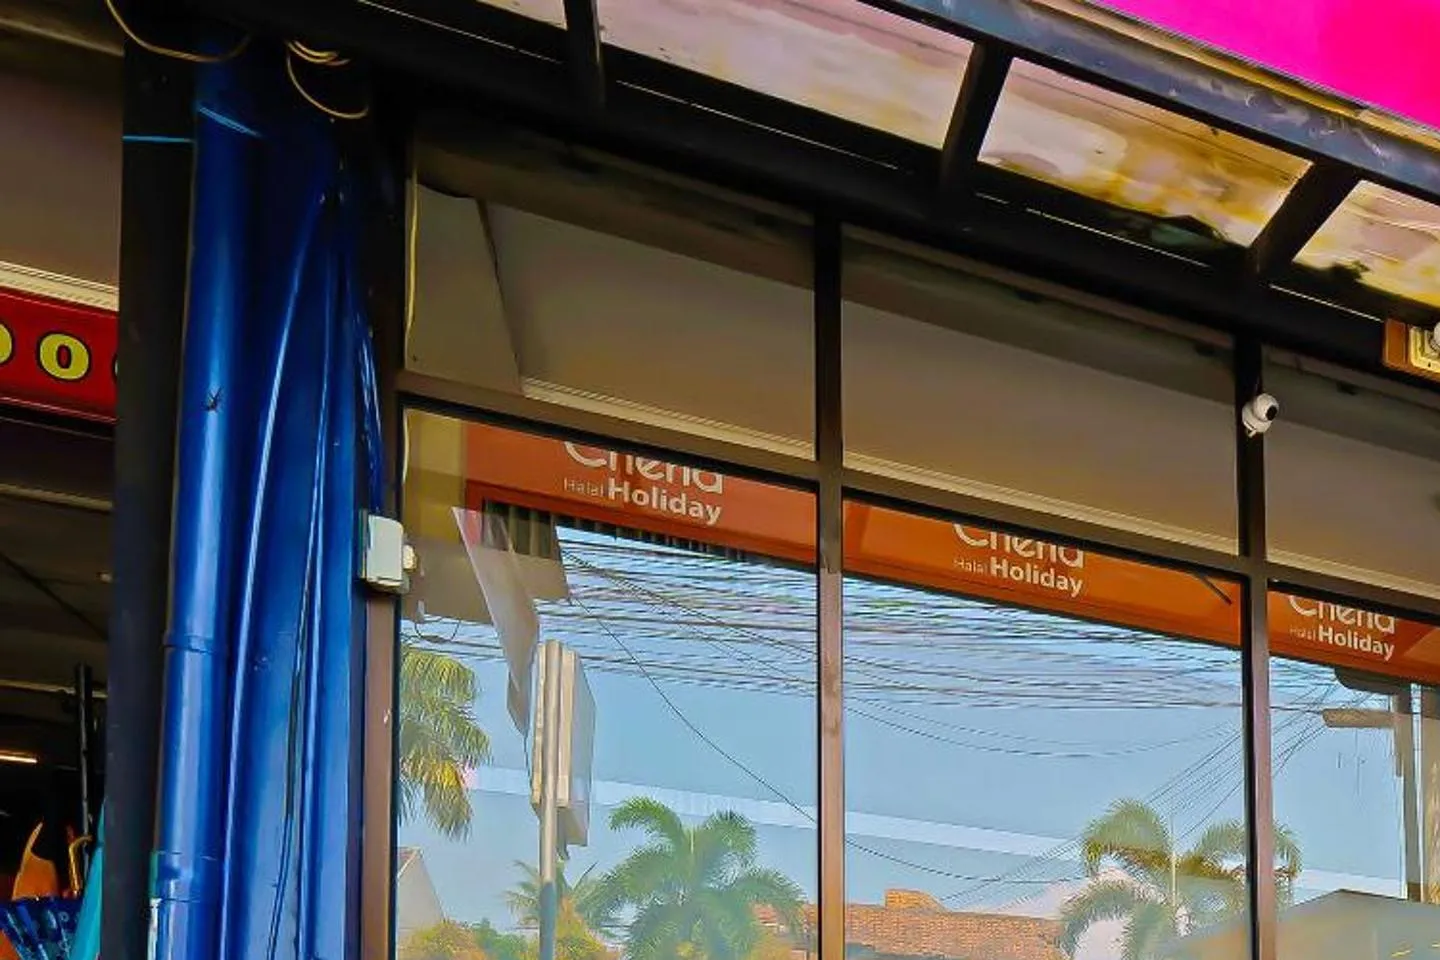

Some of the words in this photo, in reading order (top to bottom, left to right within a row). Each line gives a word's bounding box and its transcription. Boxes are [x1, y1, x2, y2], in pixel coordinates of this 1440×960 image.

[608, 477, 723, 525] Holiday
[990, 555, 1084, 597] Holiday
[1319, 623, 1396, 661] Holiday
